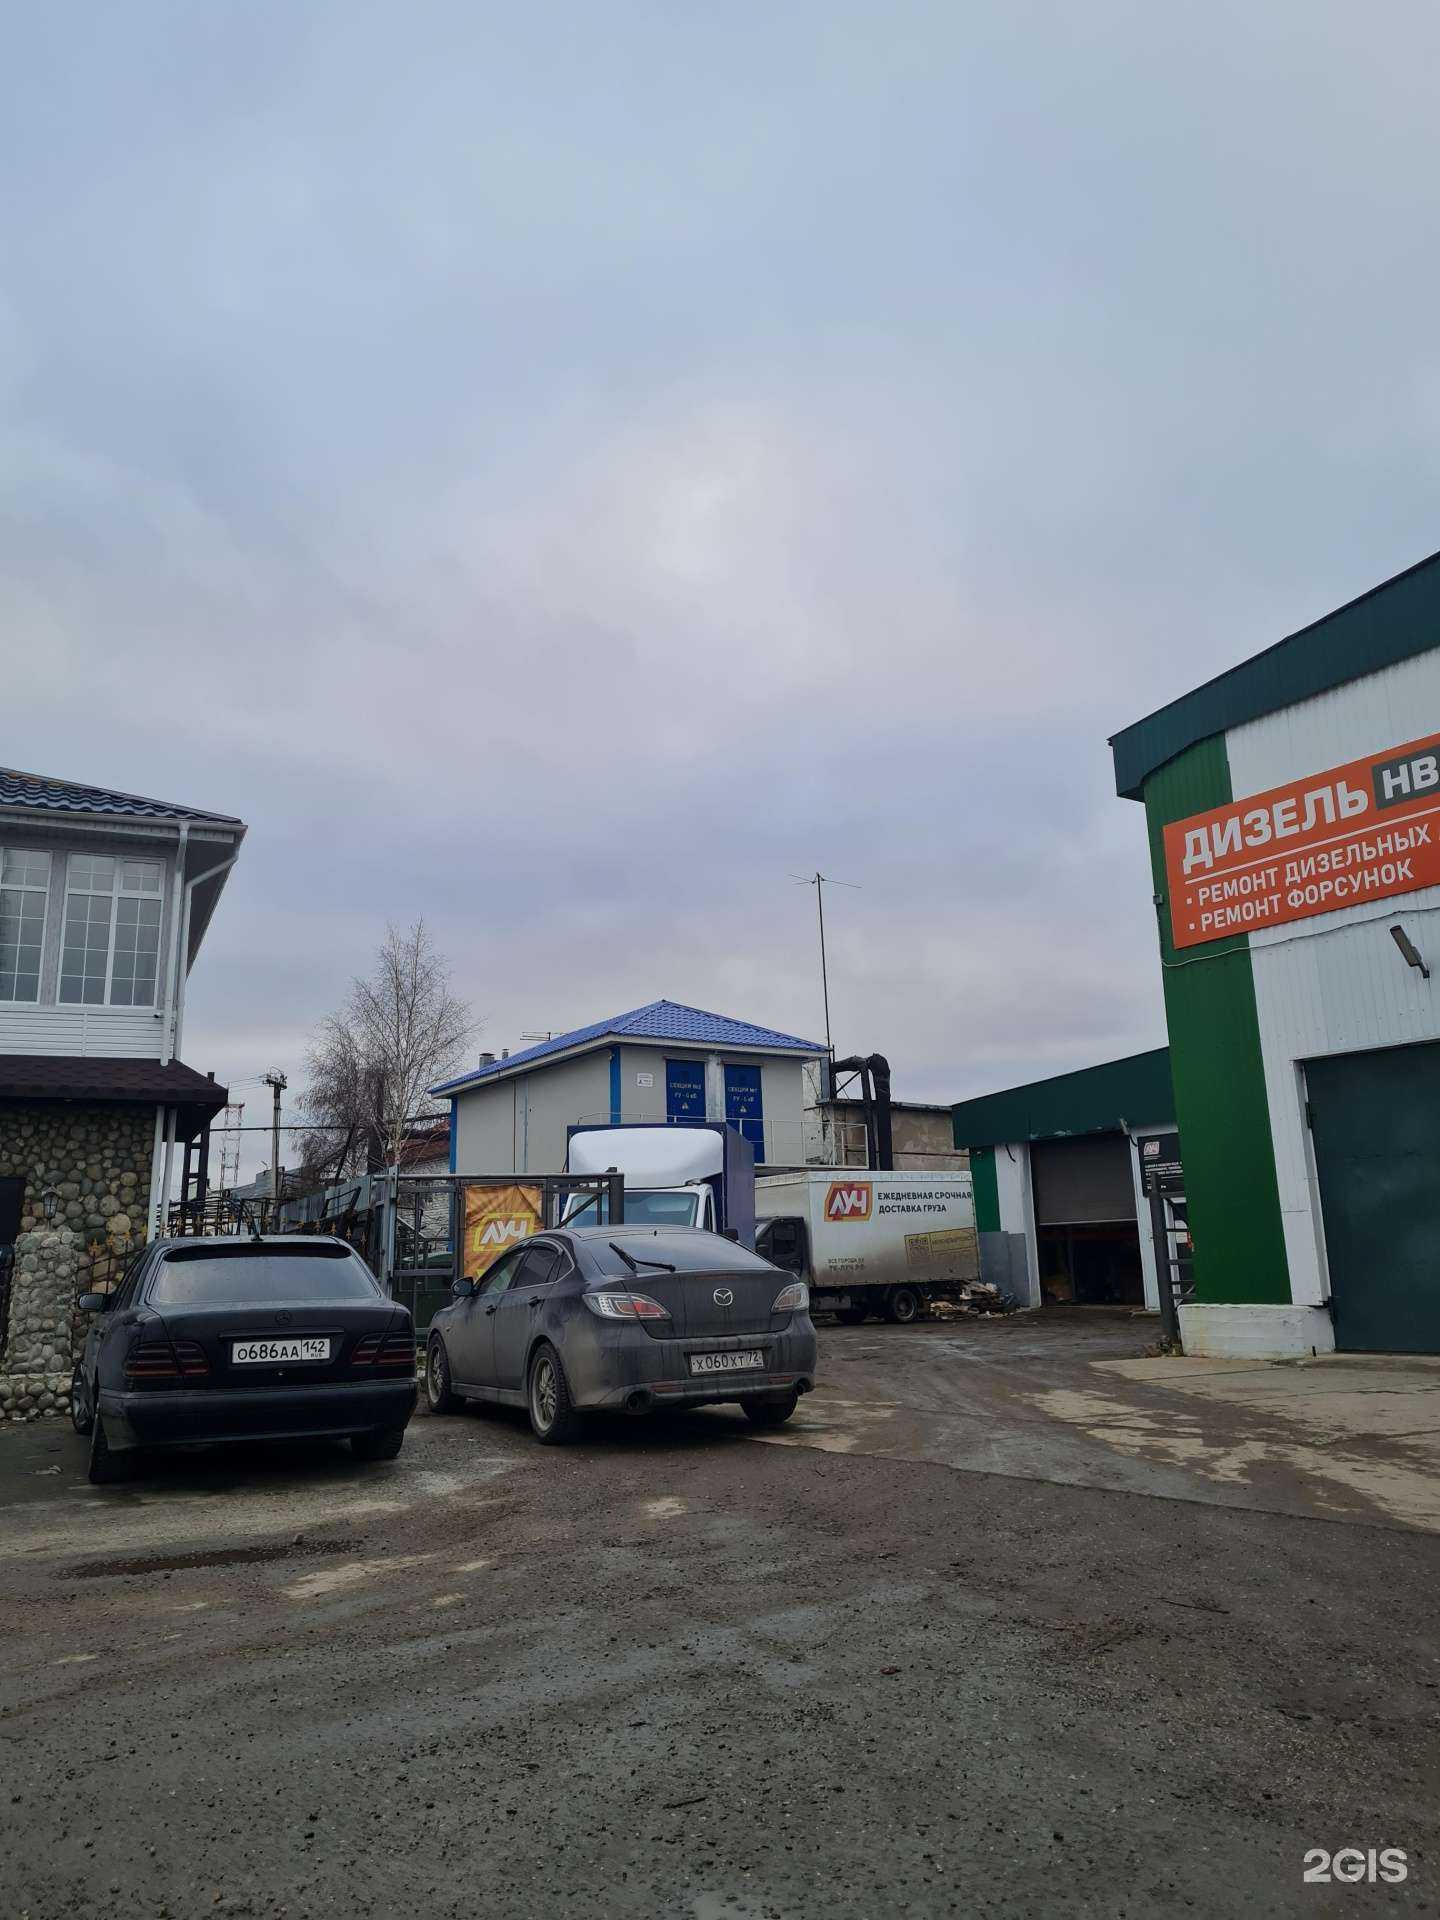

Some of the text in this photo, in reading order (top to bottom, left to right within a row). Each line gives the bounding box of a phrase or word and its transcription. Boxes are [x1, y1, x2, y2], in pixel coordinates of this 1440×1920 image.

[1183, 781, 1369, 875] ДИЗЕЛЬ
[1198, 824, 1432, 907] РЕМОНТ ДИЗЕЛЬНЫХ
[1201, 858, 1415, 932] РЕМОНТ ФОРСУНОК
[829, 1190, 867, 1215] ЛУЧ
[877, 1191, 972, 1201] ЕЖЕДНЕВНАЯ СРОЧНАЯ
[878, 1204, 947, 1214] ДОСТАВКА ГРУЗА
[480, 1219, 527, 1245] ЛУЧ
[237, 1341, 325, 1360] О686АА 142
